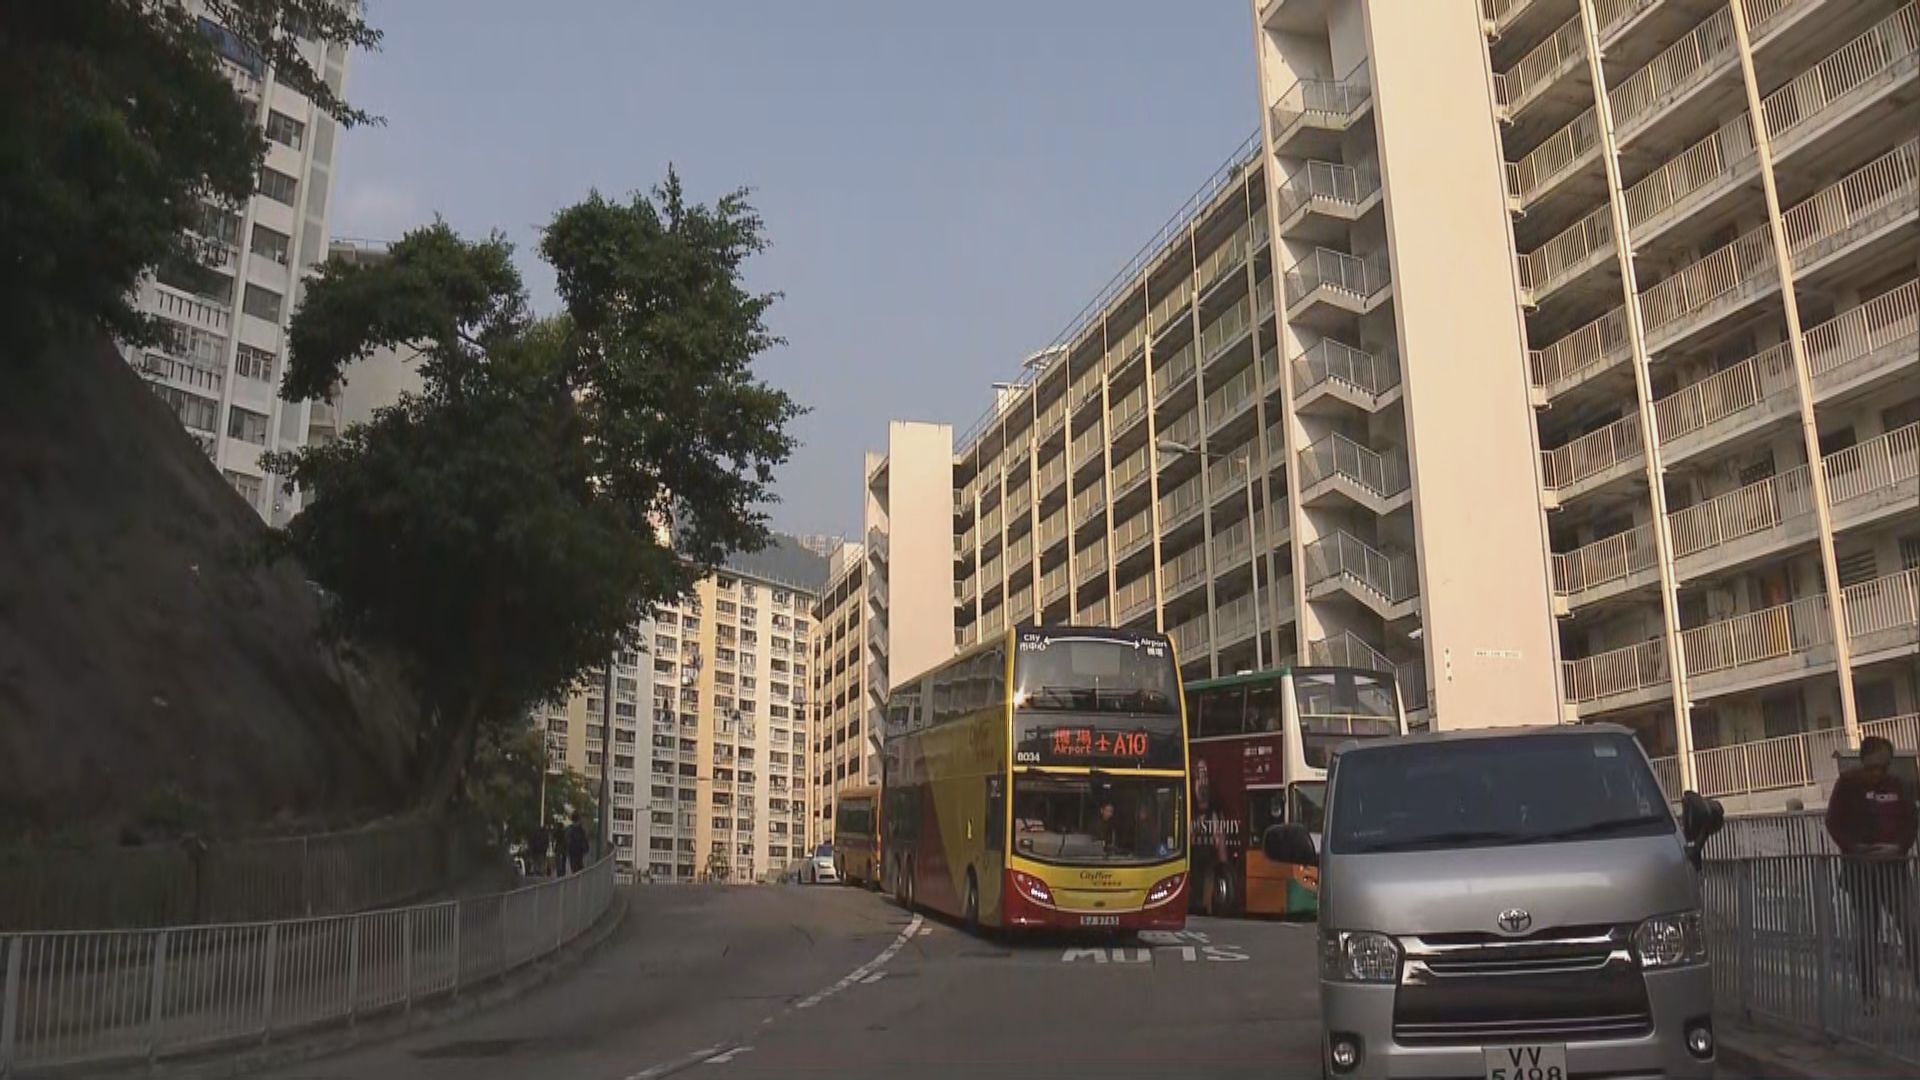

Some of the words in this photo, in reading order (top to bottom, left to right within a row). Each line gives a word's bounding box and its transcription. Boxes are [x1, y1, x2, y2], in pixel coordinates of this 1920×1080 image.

[1023, 633, 1041, 643] City
[1140, 637, 1168, 648] Airport
[1054, 743, 1093, 756] Airport
[1113, 731, 1147, 756] A10
[1508, 1046, 1542, 1067] VV
